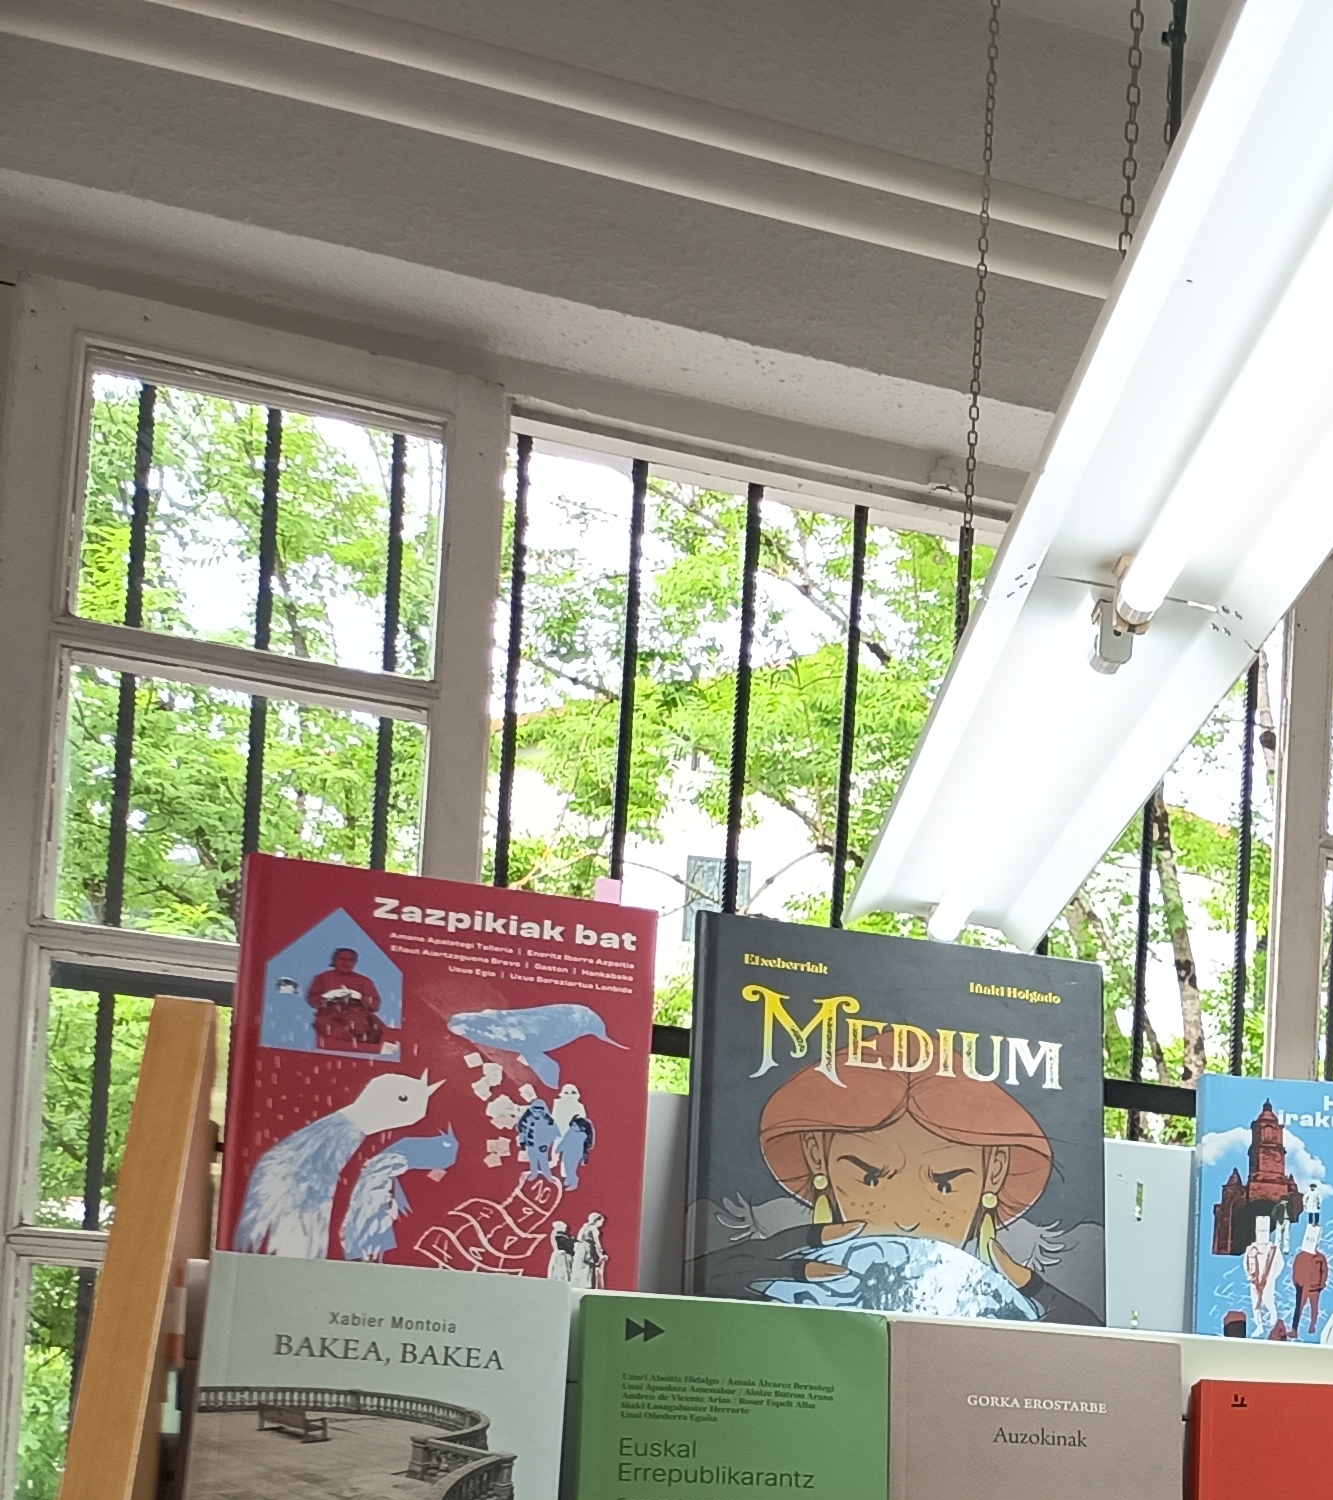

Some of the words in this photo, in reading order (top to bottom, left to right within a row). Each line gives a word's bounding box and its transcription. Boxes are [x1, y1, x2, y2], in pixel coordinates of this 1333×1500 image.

[373, 897, 565, 942] Zazpikiak
[575, 924, 637, 951] bat
[744, 953, 829, 975] Etxeberriak
[1007, 986, 1061, 1005] Holgado
[742, 985, 1062, 1090] MEDIUM
[329, 1312, 384, 1328] Xabier
[391, 1316, 457, 1333] Montoia
[274, 1334, 391, 1366] BAKEA,
[400, 1343, 504, 1370] BAKEA
[967, 1394, 1020, 1408] GORKA
[1024, 1398, 1107, 1413] EROSTARBE
[993, 1427, 1087, 1447] Auzokinak
[619, 1438, 697, 1458] Euskal
[618, 1463, 814, 1489] Errepublikarantz
